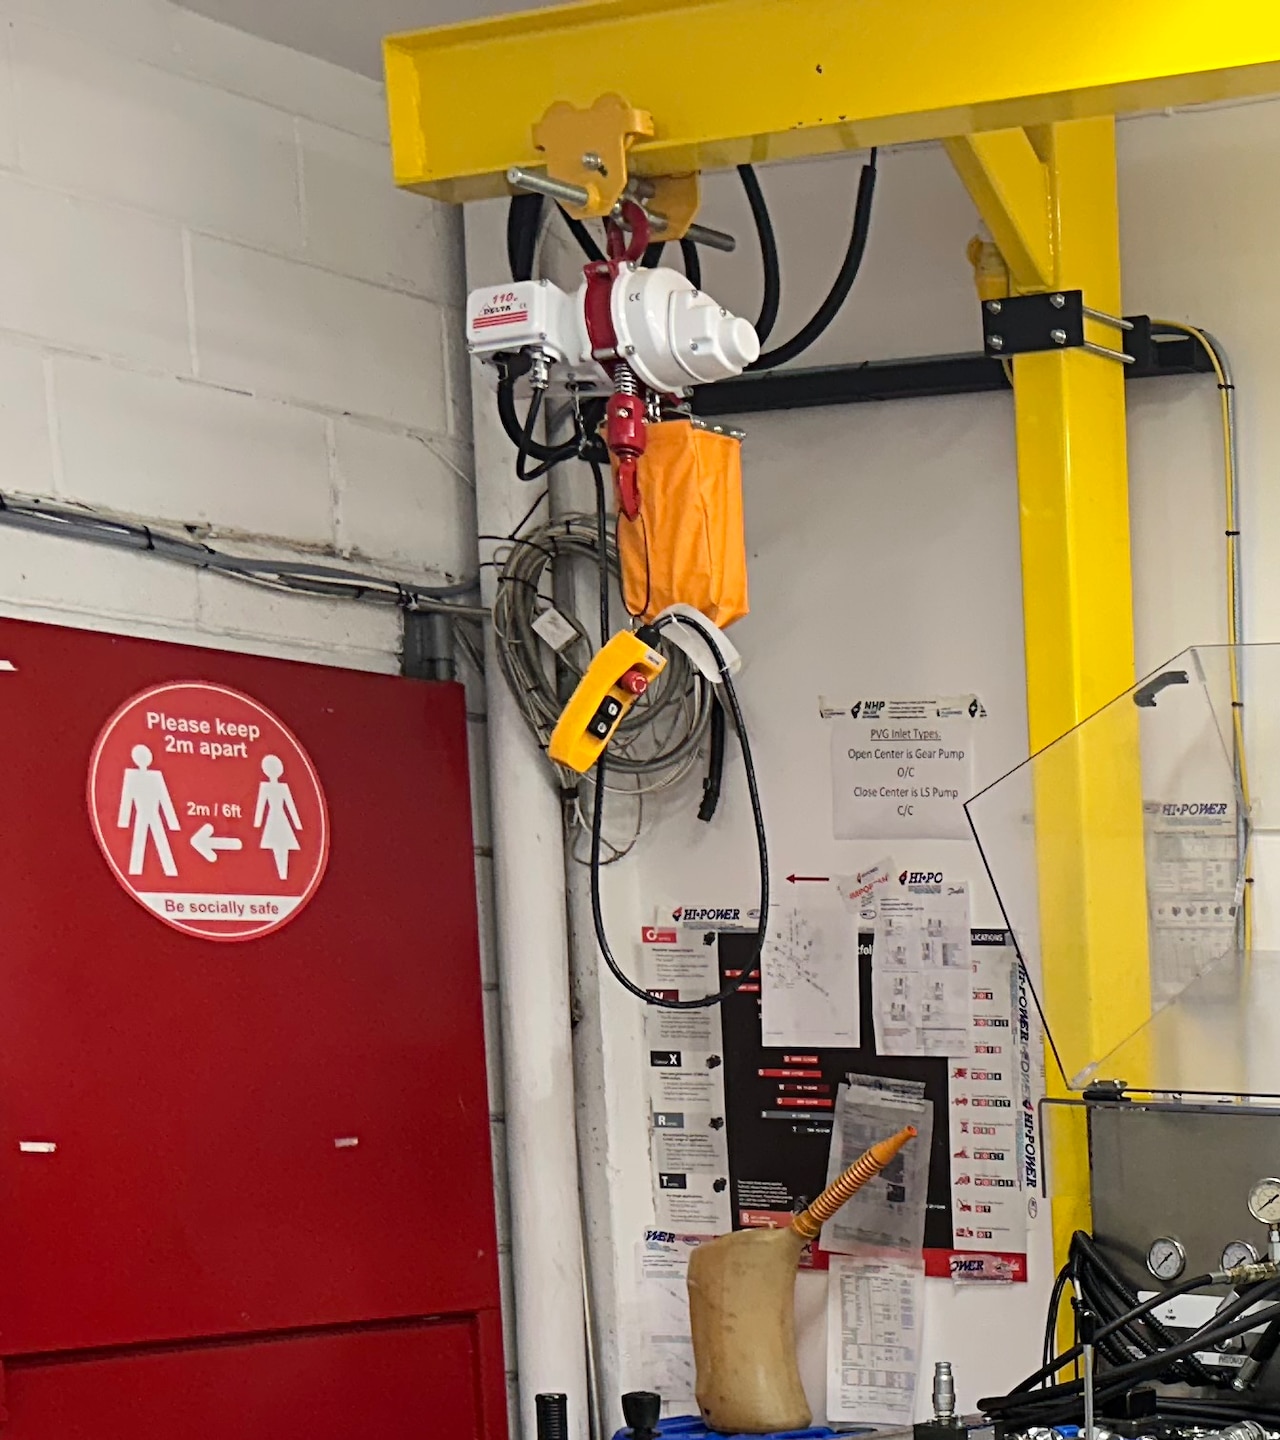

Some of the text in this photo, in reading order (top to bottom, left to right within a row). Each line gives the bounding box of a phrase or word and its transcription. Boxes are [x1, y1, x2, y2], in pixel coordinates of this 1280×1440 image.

[864, 701, 885, 711] NHP
[146, 712, 260, 741] Please keep
[871, 729, 889, 739] PVG
[891, 729, 911, 739] Inlet
[164, 735, 248, 760] 2m apart
[848, 749, 965, 761] Open Center is Gear Pump
[897, 767, 915, 778] O/C
[854, 787, 958, 799] Close Center is LS Pump
[187, 801, 210, 816] 2m
[222, 803, 242, 818] 6ft
[897, 805, 914, 817] C/C
[164, 898, 279, 917] Be socially safe
[669, 1054, 677, 1065] X
[658, 1115, 666, 1126] R
[661, 1176, 668, 1186] T
